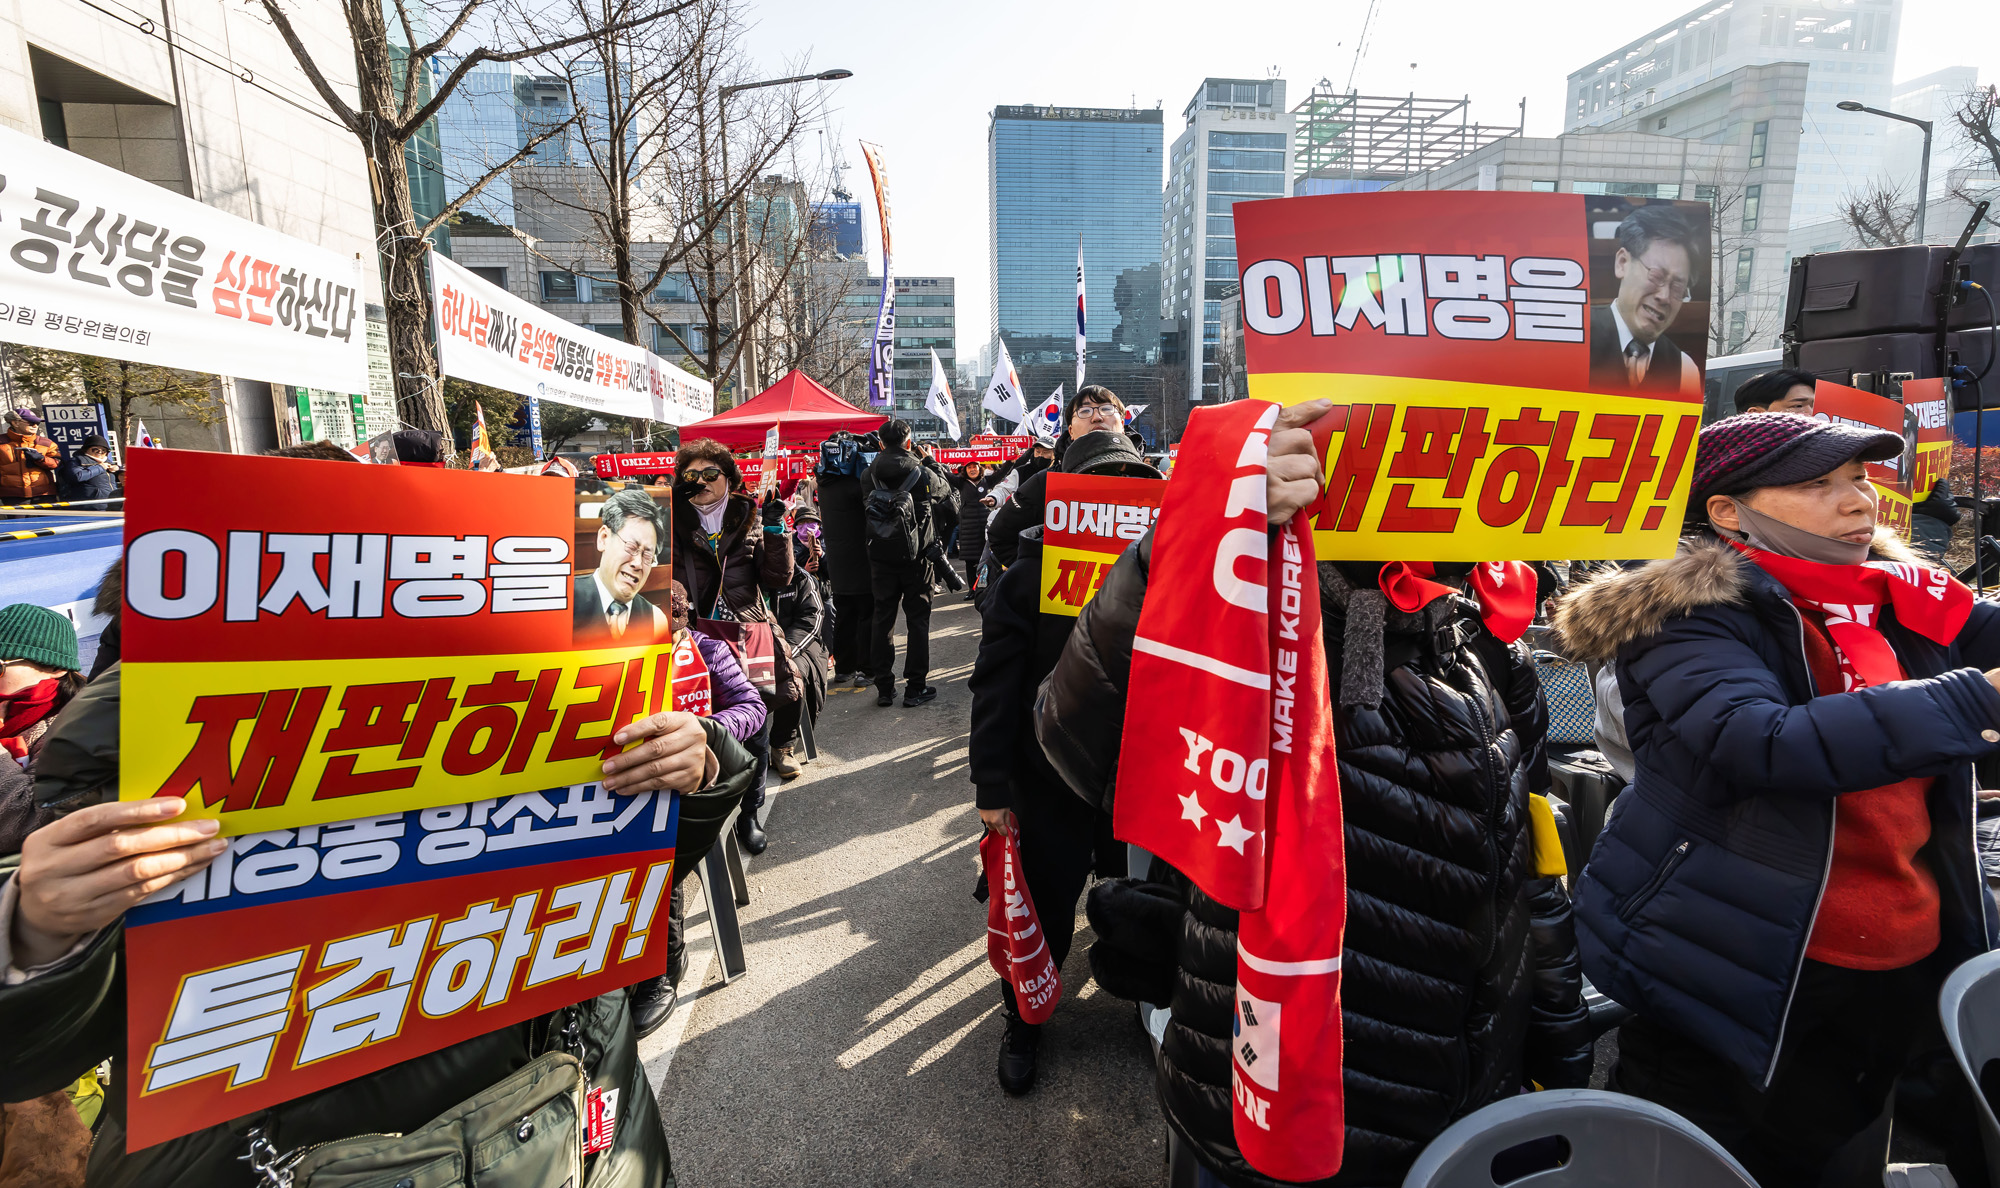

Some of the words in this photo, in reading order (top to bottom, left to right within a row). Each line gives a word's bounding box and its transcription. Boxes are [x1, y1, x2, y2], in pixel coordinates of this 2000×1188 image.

[10, 187, 206, 309] 공산당을
[212, 249, 357, 343] 심판하신다
[1241, 253, 1587, 343] 이재명을
[44, 312, 151, 346] 평당원협의회
[442, 284, 517, 358] 하나님께서
[519, 322, 595, 382] 윤석열대통령님
[595, 351, 613, 387] 부활
[51, 408, 94, 420] 101호
[621, 457, 655, 467] ONLY,
[1305, 403, 1700, 535] 재판하라!
[126, 528, 571, 622] 이재명을
[152, 652, 671, 812] 재판하라!
[677, 689, 712, 705] YOON
[1272, 648, 1298, 754] MAKE
[142, 860, 673, 1096] 특검하라!
[1019, 954, 1055, 994] AGAIN
[1027, 975, 1058, 1009] 2025
